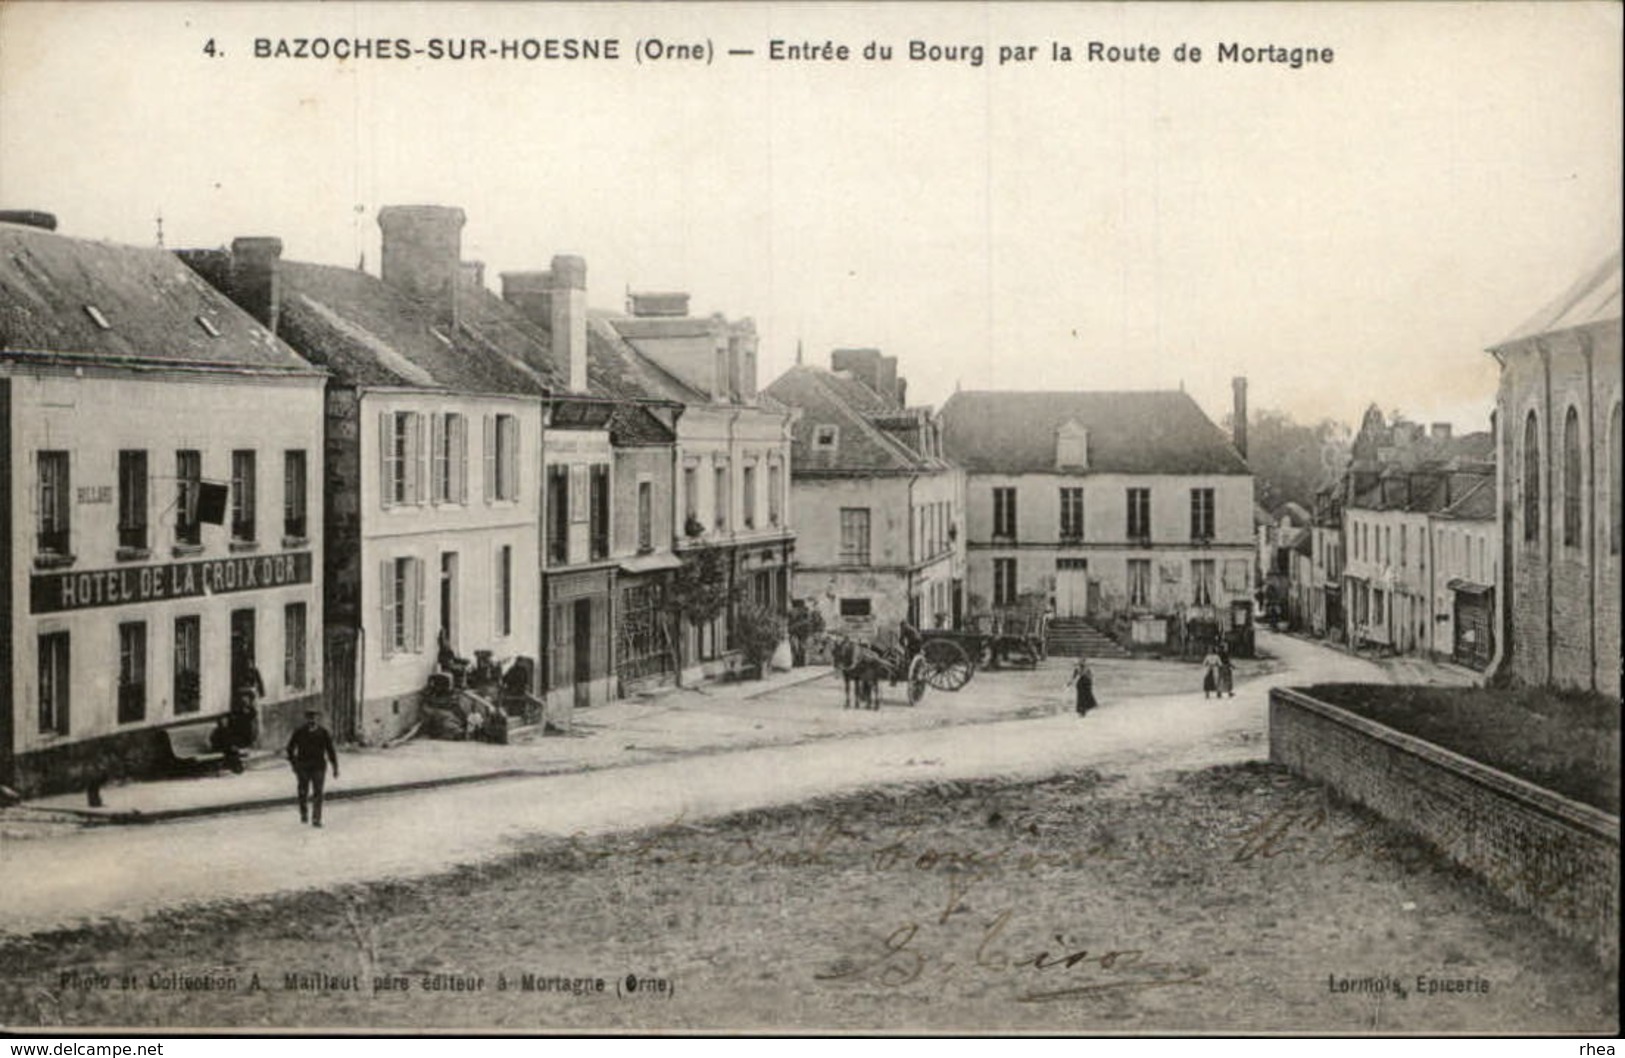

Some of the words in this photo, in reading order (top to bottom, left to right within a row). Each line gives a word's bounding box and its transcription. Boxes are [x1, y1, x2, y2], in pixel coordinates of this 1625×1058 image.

[141, 566, 164, 598] DE
[172, 563, 195, 594] LA
[202, 557, 257, 594] CROIX
